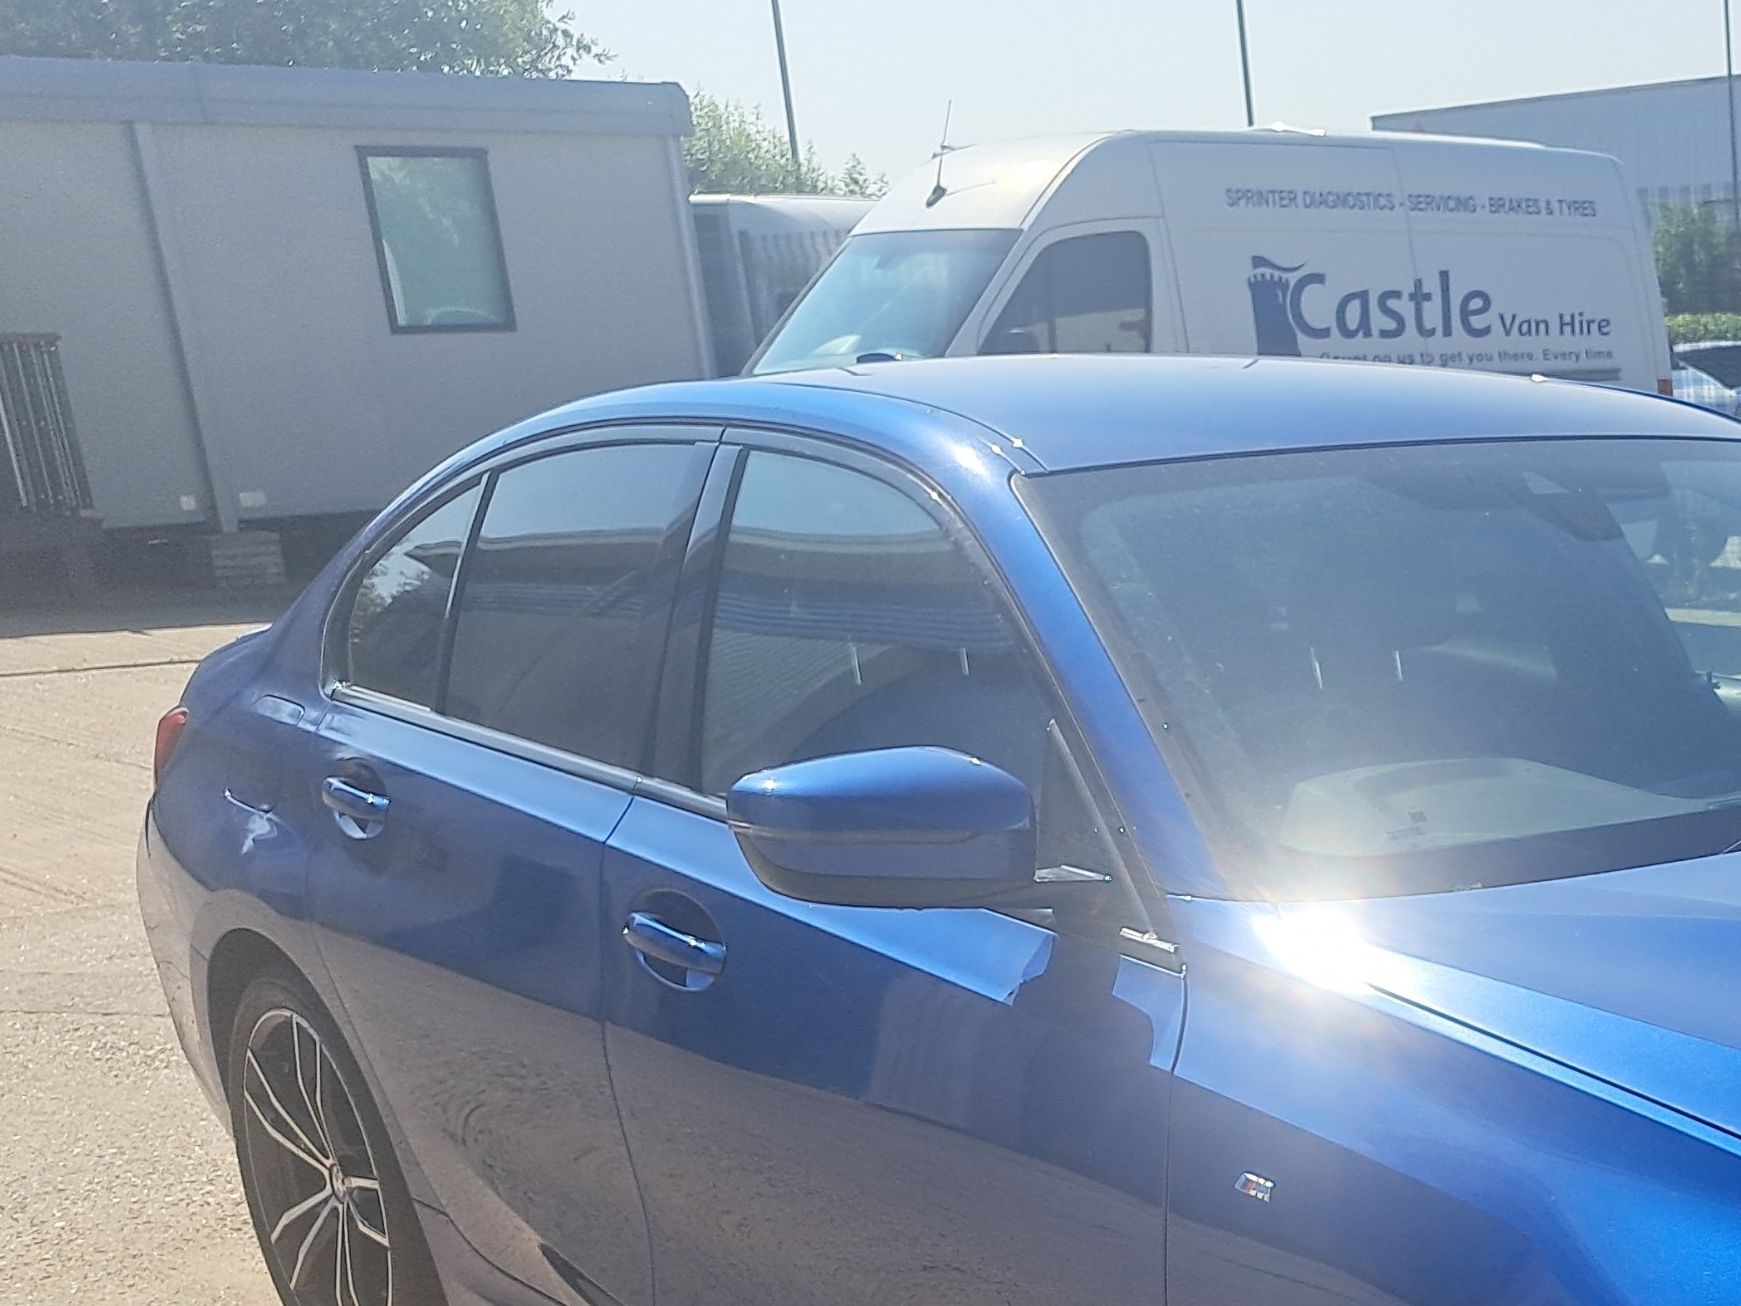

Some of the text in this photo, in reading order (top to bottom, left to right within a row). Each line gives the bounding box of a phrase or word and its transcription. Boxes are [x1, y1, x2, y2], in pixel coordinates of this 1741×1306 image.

[1225, 188, 1299, 209] SPRINTER
[1303, 190, 1396, 211] DIAGNOSTICS
[1407, 194, 1477, 213] SERVICING
[1488, 196, 1541, 215] BRAKES
[1545, 198, 1554, 216] &
[1557, 199, 1597, 217] TYRES
[1289, 269, 1612, 340] Castle Van Hire
[1439, 350, 1463, 368] get
[1466, 351, 1494, 366] you
[1542, 348, 1580, 363] Every
